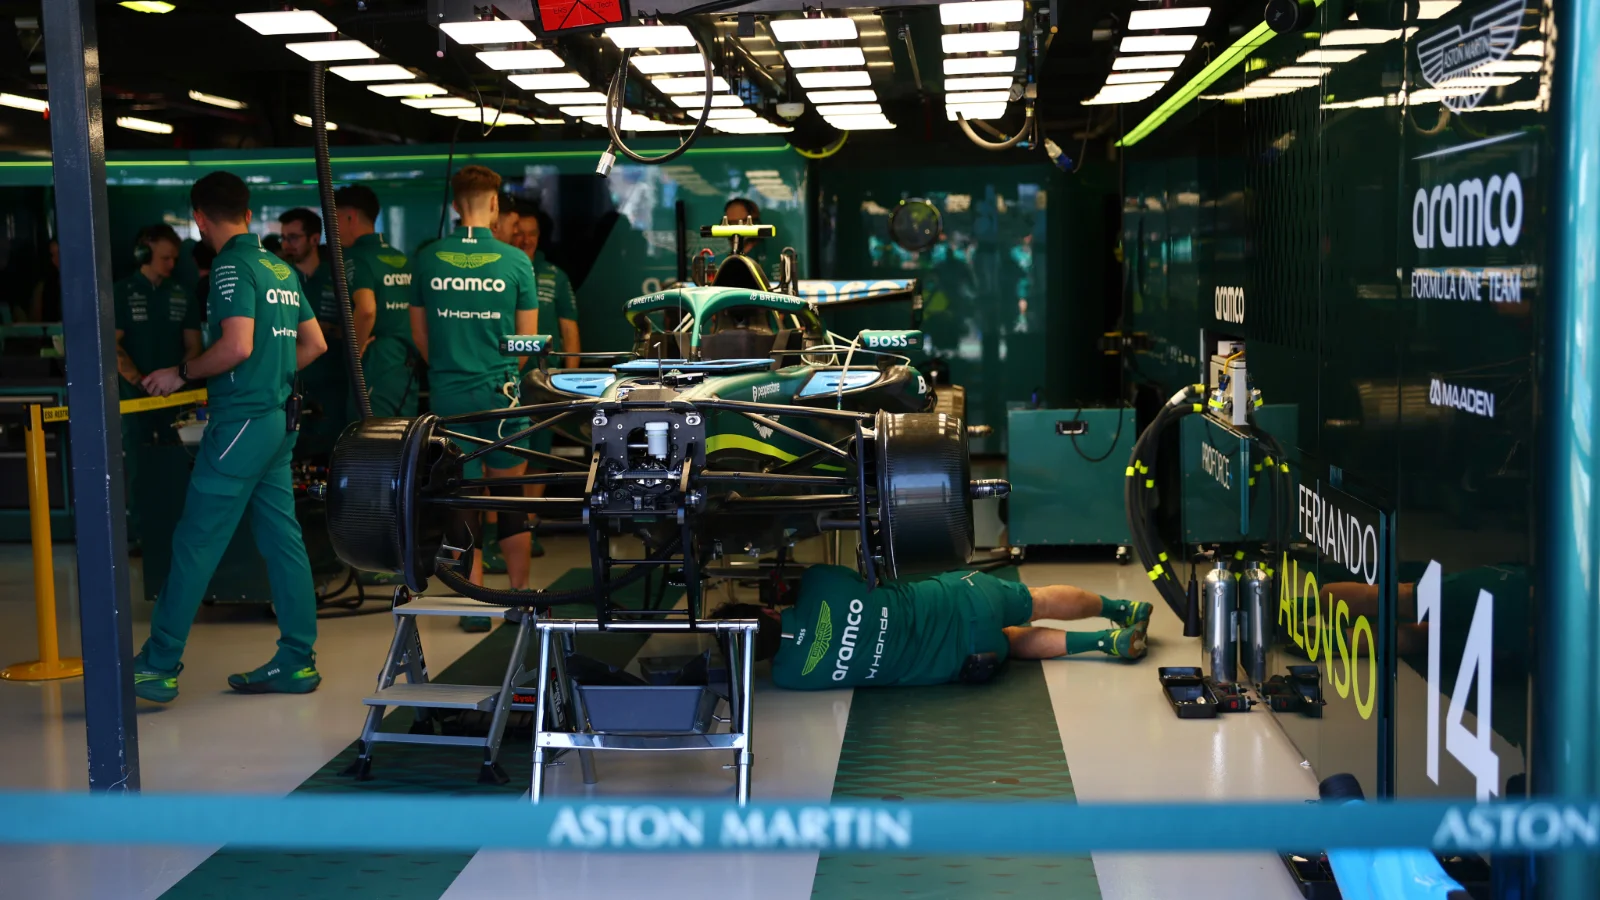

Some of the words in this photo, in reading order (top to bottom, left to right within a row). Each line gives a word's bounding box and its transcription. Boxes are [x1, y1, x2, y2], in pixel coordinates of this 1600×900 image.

[1413, 172, 1523, 248] aramco
[430, 276, 506, 292] aramco
[632, 293, 665, 306] BREITLING
[759, 294, 801, 305] BREITLING
[1411, 272, 1456, 299] FORMULA
[1458, 270, 1482, 301] ONE
[1488, 270, 1521, 303] TEAM
[449, 309, 501, 320] Honda
[1215, 285, 1245, 324] aramco
[507, 340, 541, 352] BOSS
[869, 334, 908, 348] BOSS
[757, 382, 780, 398] pepperstone
[1442, 382, 1494, 417] MAADEN
[1201, 440, 1231, 491] PROFORCE
[796, 628, 807, 646] BOSS
[831, 599, 864, 681] aramco
[871, 606, 889, 667] Honda
[267, 667, 281, 676] BOSS
[1417, 559, 1500, 802] 14
[548, 804, 704, 848] ASTON
[718, 804, 911, 849] MARTIN
[1433, 803, 1600, 849] ASTON
